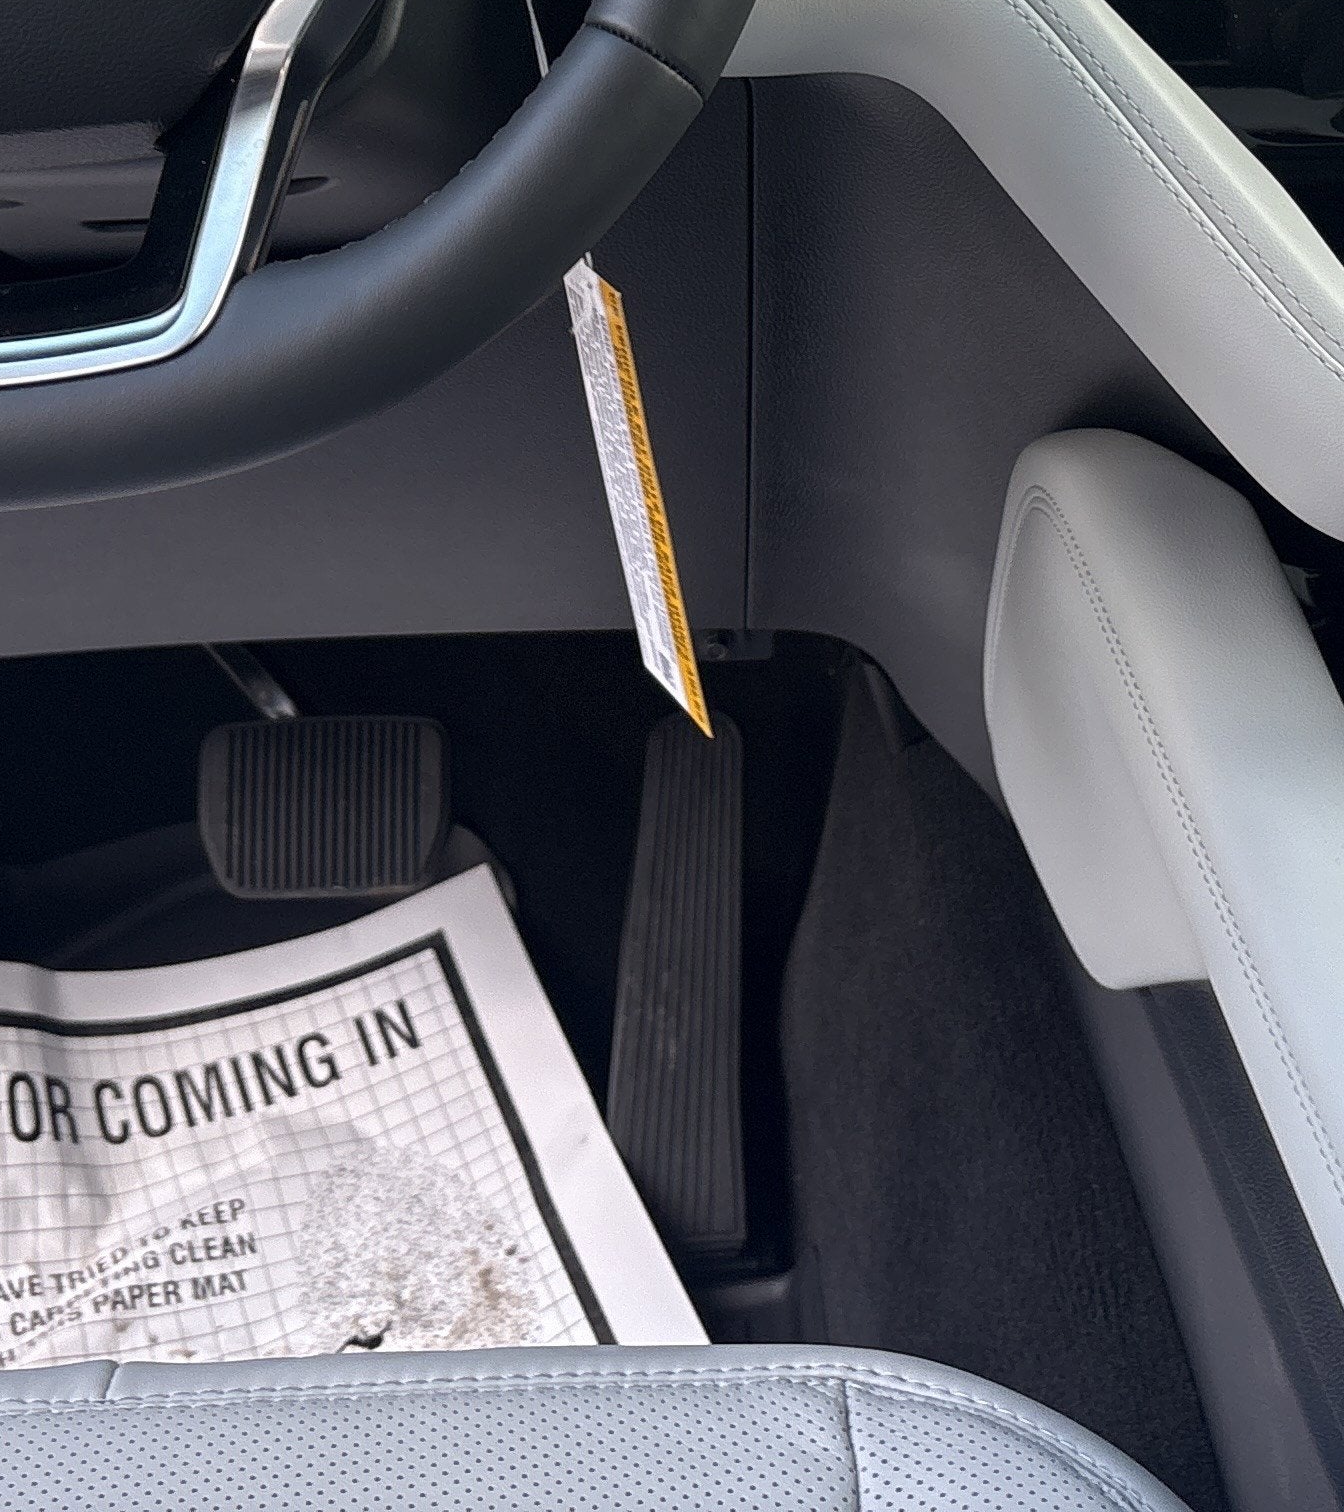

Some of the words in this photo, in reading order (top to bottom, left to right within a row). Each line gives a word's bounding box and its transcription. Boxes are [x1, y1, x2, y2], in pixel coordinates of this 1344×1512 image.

[95, 1031, 342, 1147] COMING
[362, 999, 423, 1067] IN
[47, 1245, 128, 1295] TRIED
[180, 1197, 246, 1231] KEEP
[168, 1232, 258, 1267] CLEAN
[92, 1279, 183, 1316] PAPER
[192, 1268, 249, 1301] MAT
